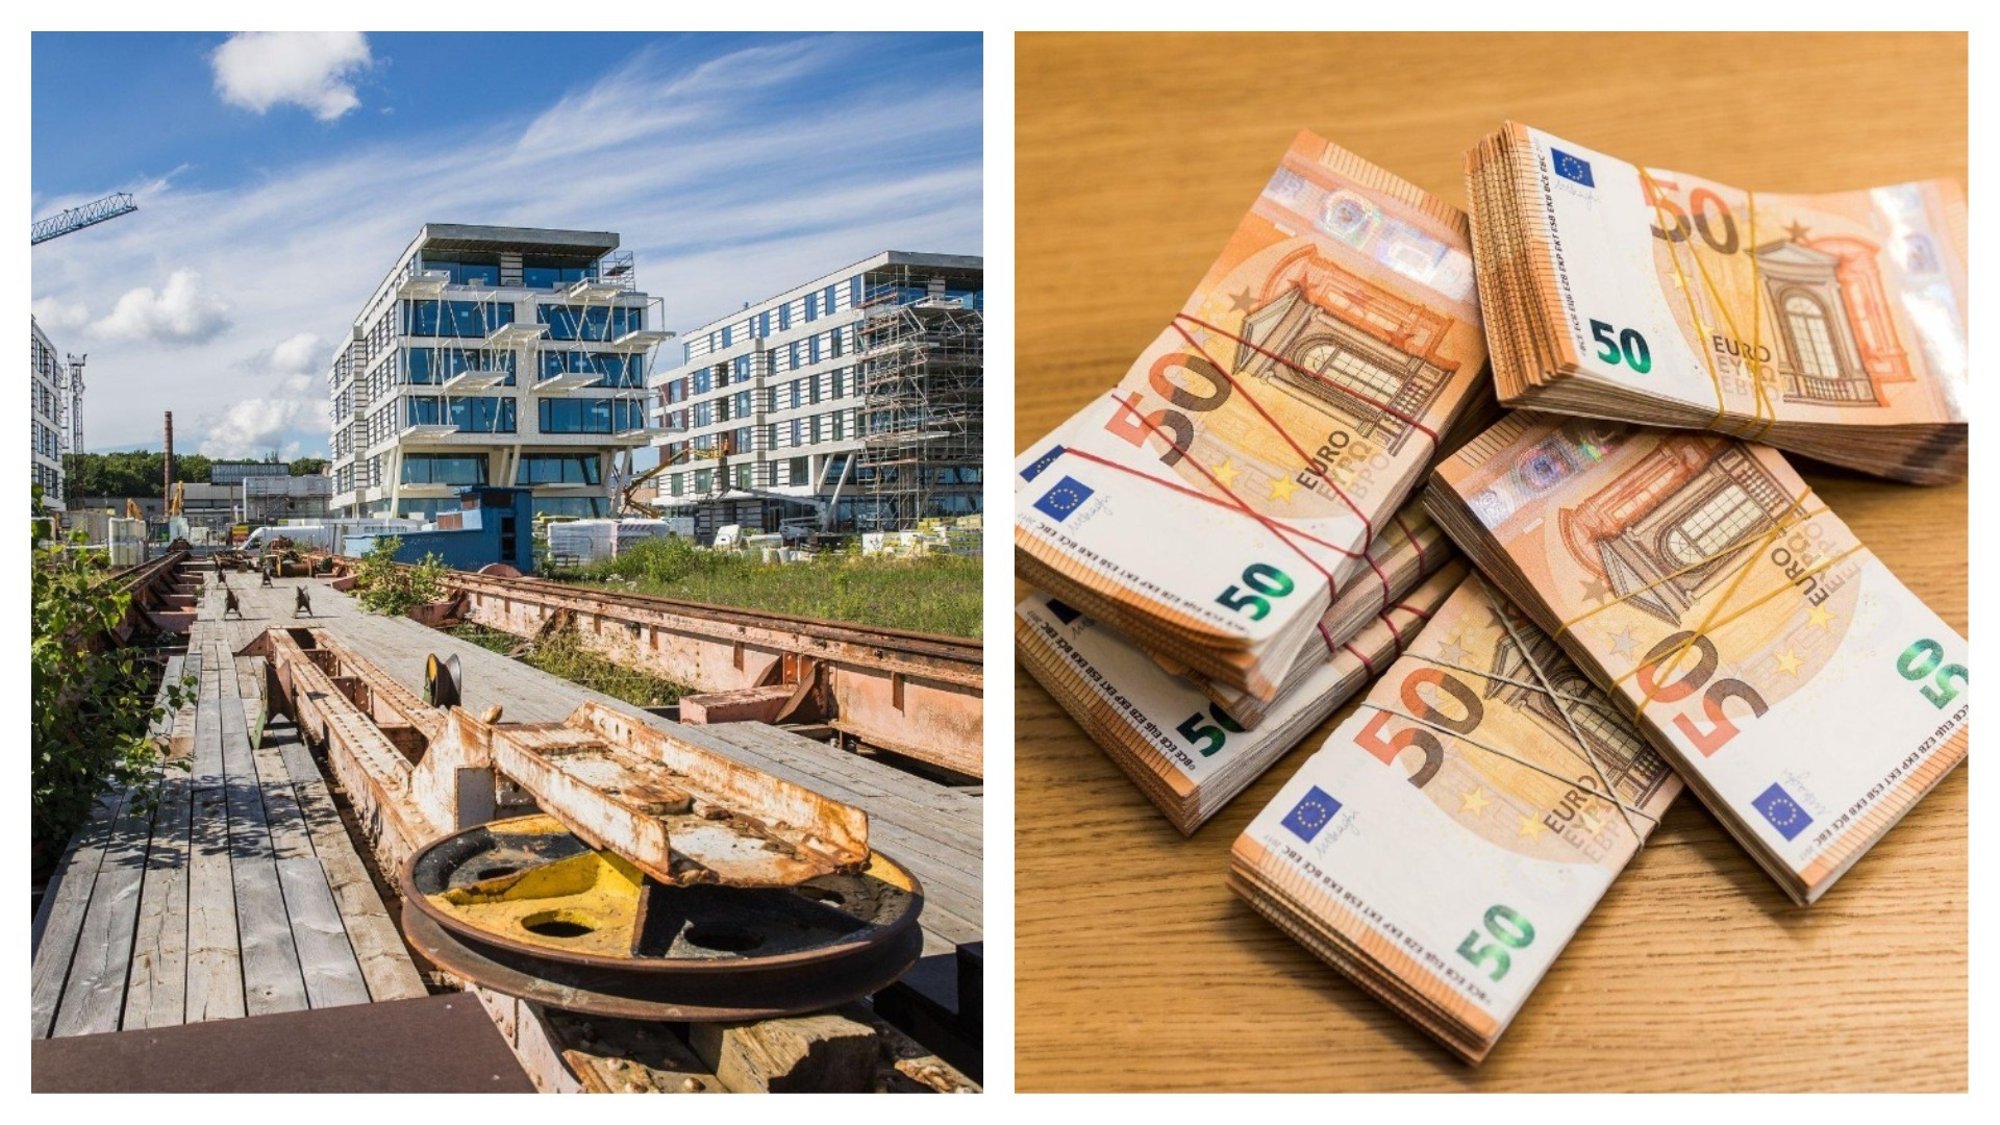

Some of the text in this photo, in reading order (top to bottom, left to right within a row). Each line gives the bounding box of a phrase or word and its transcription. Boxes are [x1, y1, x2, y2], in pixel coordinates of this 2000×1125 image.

[1536, 153, 1548, 173] EBC
[1544, 194, 1555, 214] EKB
[1547, 214, 1558, 233] ESB
[1639, 174, 1739, 255] 50
[1551, 232, 1563, 252] EKT
[1555, 252, 1567, 273] EKP
[1559, 273, 1571, 292] EZB
[1590, 319, 1651, 374] 50
[1713, 335, 1771, 363] EURO
[1104, 353, 1232, 467] 50
[1296, 430, 1349, 490] EURO
[1036, 522, 1058, 538] EBC
[1077, 546, 1099, 561] EKB
[1098, 558, 1120, 572] ESB
[1771, 547, 1829, 607] EURO
[1215, 563, 1295, 621] 50
[1039, 620, 1059, 640] EBC
[1069, 650, 1089, 669] EKB
[1084, 665, 1103, 682] ESB
[1897, 639, 1969, 709] 50
[1098, 680, 1118, 697] EKT
[1637, 631, 1769, 758] 50
[1113, 695, 1133, 711] EKP
[1128, 707, 1148, 725] EZB
[1353, 668, 1483, 789] 50
[1158, 735, 1178, 753] ECB
[1917, 735, 1937, 754] EZB
[1901, 751, 1920, 770] EKP
[1883, 766, 1902, 786] EKT
[1865, 782, 1885, 801] ESB
[1543, 775, 1598, 834] EURO
[1848, 797, 1868, 816] EKB
[1812, 828, 1833, 846] EBC
[1283, 845, 1303, 864] EBC
[1322, 875, 1344, 894] EKB
[1342, 891, 1364, 908] ESB
[1362, 906, 1383, 923] EKT
[1382, 922, 1404, 939] EKP
[1403, 936, 1424, 954] EZB
[1456, 905, 1535, 983] 50
[1445, 967, 1466, 985] ECB
